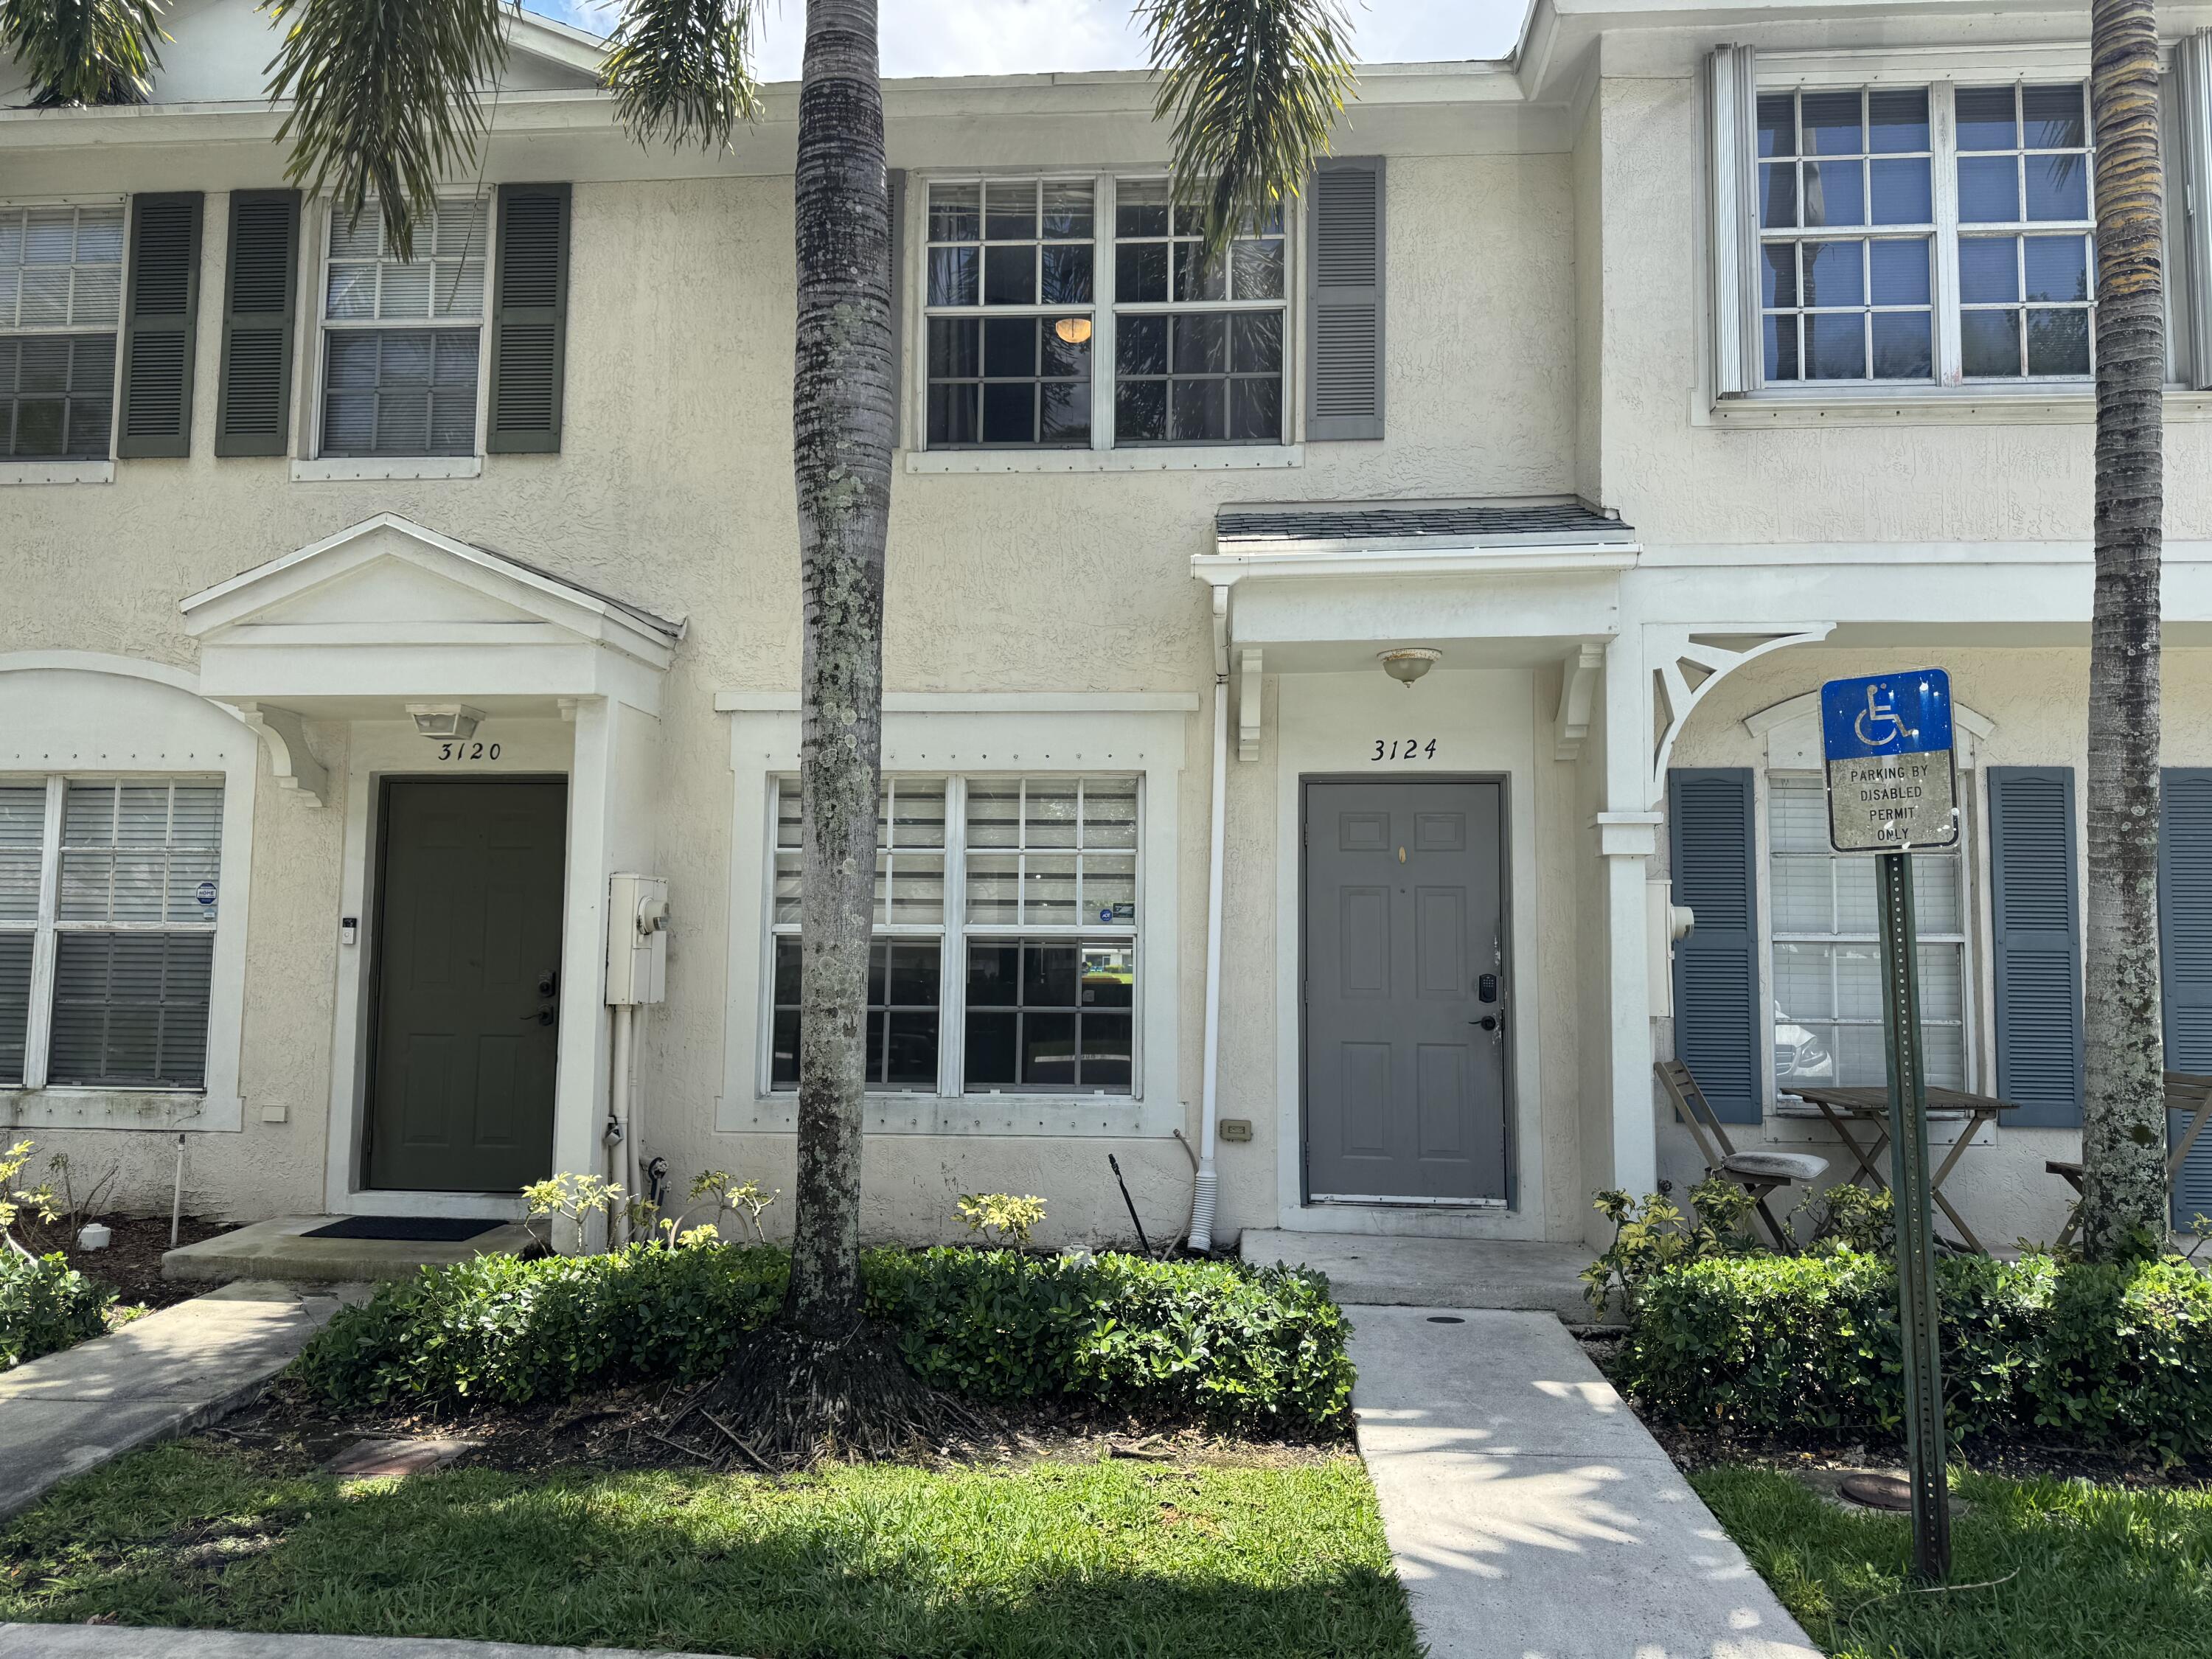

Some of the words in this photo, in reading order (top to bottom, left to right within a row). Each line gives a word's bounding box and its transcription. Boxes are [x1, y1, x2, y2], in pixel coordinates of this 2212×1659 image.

[438, 742, 501, 761] 3120
[1371, 738, 1437, 761] 3124
[1851, 767, 1905, 782] PARKING
[1912, 765, 1929, 777] BY
[1860, 786, 1922, 801] DISABLED
[1869, 807, 1915, 821] PERMIT
[1877, 827, 1909, 841] ONLY
